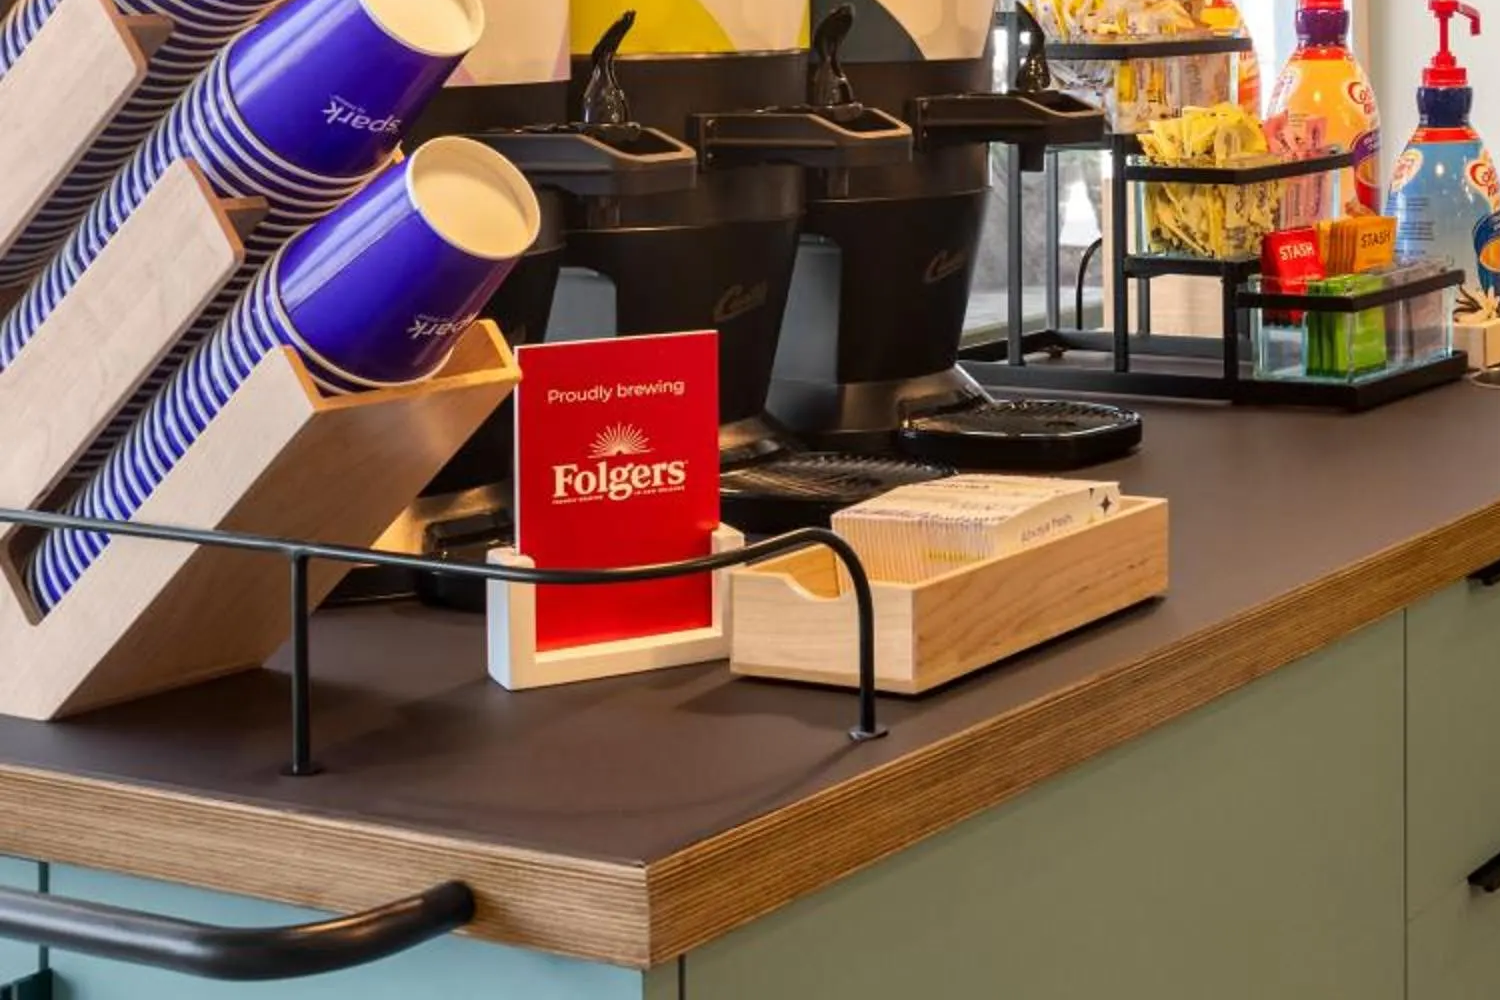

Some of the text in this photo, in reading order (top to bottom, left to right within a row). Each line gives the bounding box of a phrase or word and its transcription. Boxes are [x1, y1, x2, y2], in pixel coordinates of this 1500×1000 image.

[1360, 230, 1391, 249] STASH
[1279, 241, 1315, 261] STASH
[547, 379, 685, 404] Proudly brewing
[552, 459, 689, 501] Folgers
